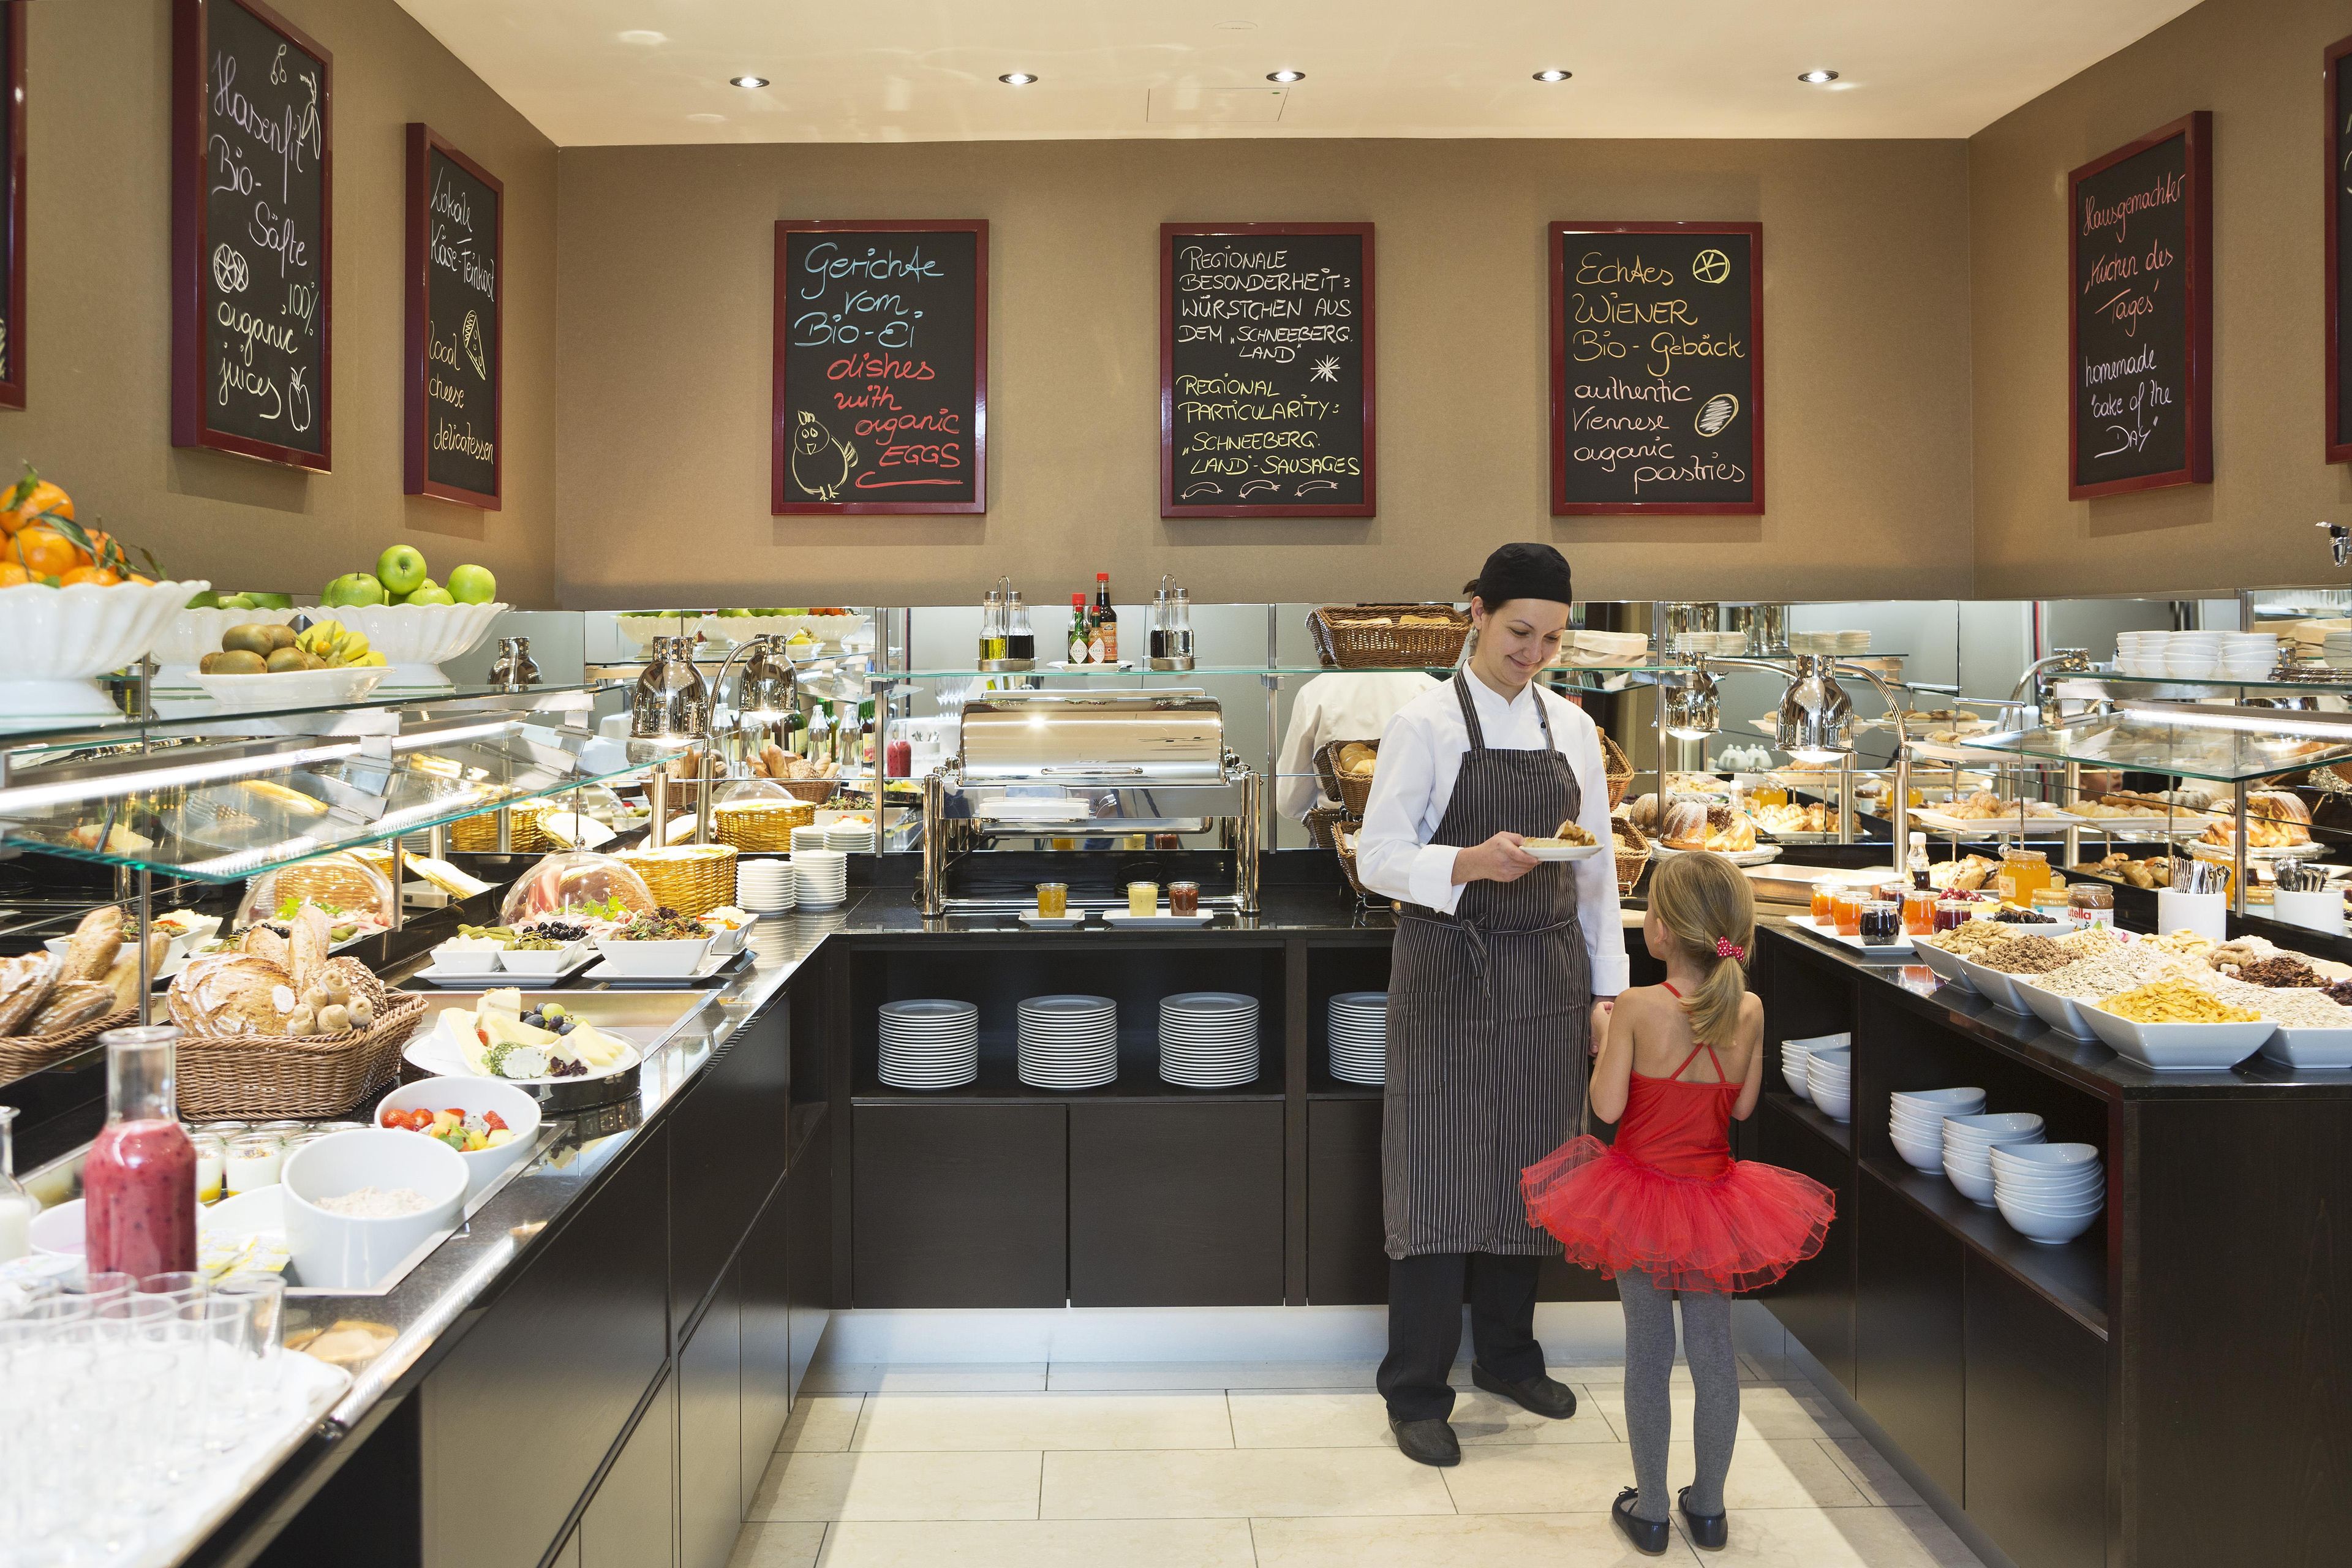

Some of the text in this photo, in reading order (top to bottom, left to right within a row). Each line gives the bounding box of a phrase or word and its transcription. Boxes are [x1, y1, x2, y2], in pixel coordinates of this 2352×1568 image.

[430, 167, 473, 233] Lokale
[2082, 171, 2186, 244] Hausgemachter
[249, 201, 307, 279] Säfte
[2145, 238, 2174, 271] des
[801, 241, 944, 300] Gerichte
[1575, 251, 1674, 286] Echtes
[289, 282, 320, 336] 100%
[1182, 295, 1352, 320] WÜRSTCHEN AUS
[1572, 292, 1698, 326] WIENER
[429, 320, 461, 371] local
[1178, 325, 1223, 344] DEM
[218, 342, 282, 420] juices
[826, 352, 935, 380] dishes
[2085, 342, 2157, 388] homemade
[429, 372, 464, 409] cheese
[834, 385, 902, 410] with
[1175, 372, 1280, 398] REGIONAL
[1574, 376, 1693, 403] authentic
[1572, 405, 1670, 432] Viennese
[2129, 381, 2144, 429] of
[433, 417, 494, 465] delicatessen
[854, 408, 960, 446] organic
[878, 442, 960, 468] EGGS
[1574, 435, 1675, 473] organic
[1634, 451, 1745, 495] pastries
[2067, 906, 2092, 920] utella
